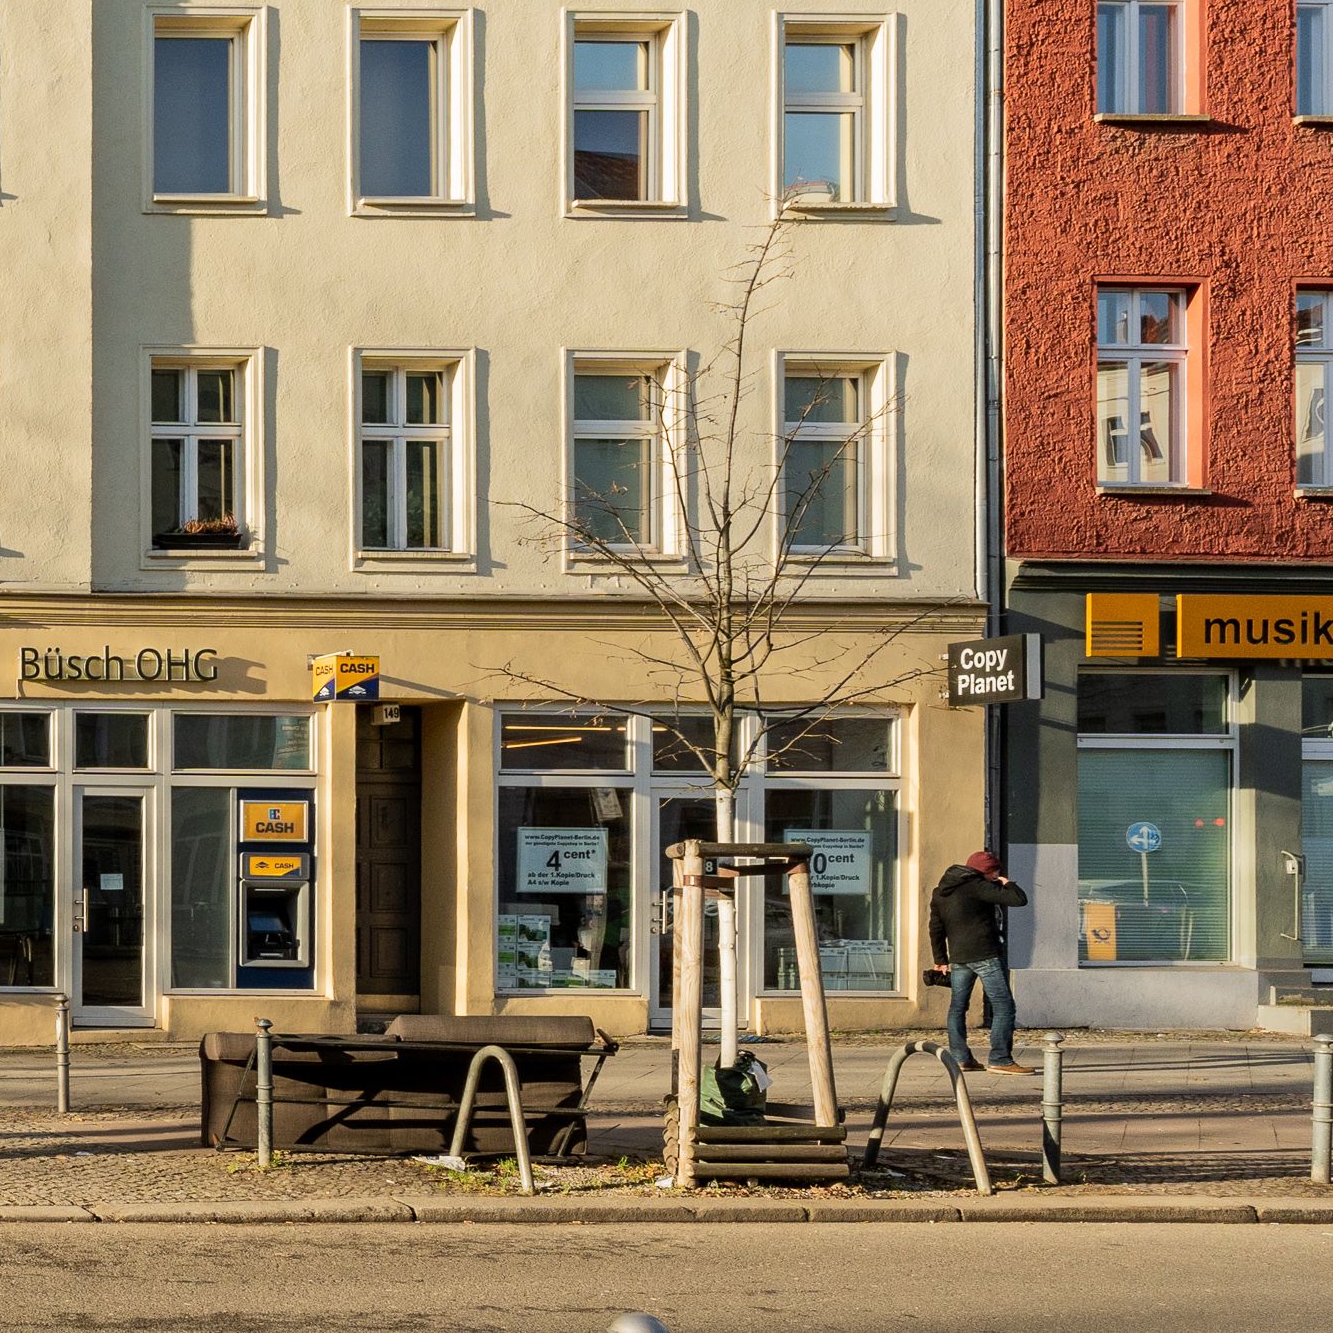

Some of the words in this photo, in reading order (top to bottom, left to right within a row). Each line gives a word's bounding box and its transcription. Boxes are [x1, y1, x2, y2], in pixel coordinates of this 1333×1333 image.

[20, 645, 124, 680] Büsch
[136, 648, 218, 681] OHG
[960, 647, 1008, 673] Copy
[316, 664, 333, 676] CASH
[340, 663, 375, 674] CASH
[957, 670, 1015, 696] Planet
[383, 707, 400, 719] 149
[255, 822, 294, 834] CASH
[546, 850, 562, 872] 4
[828, 853, 855, 863] cent
